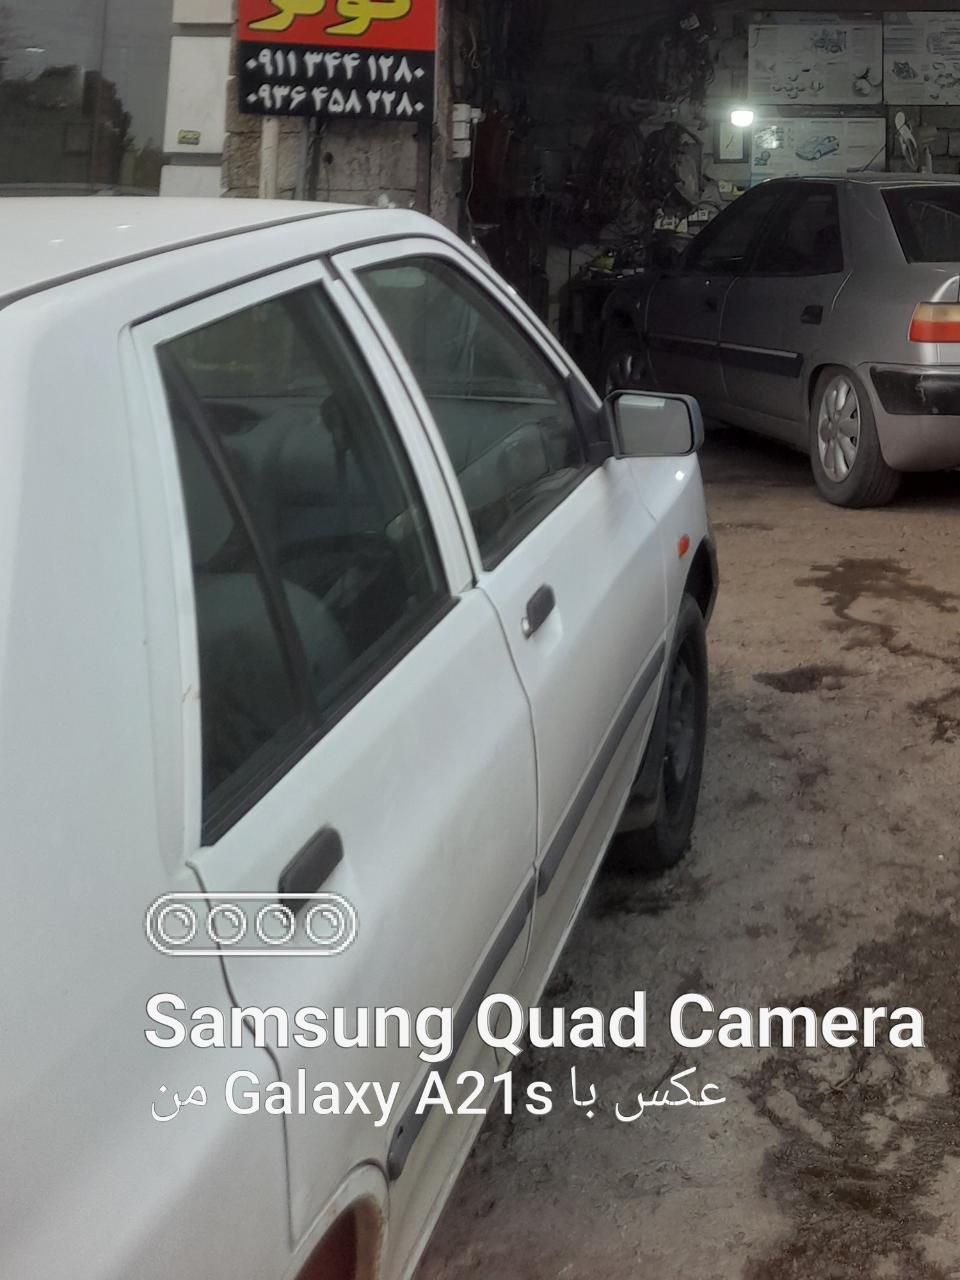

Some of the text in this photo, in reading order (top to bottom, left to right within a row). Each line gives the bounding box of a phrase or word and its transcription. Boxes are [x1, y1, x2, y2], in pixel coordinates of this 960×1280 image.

[303, 50, 361, 79] ۳۴۴
[367, 54, 425, 83] ۱۲۸۰
[311, 86, 362, 113] ۴۵۸
[366, 89, 425, 116] ۲۲۸۰
